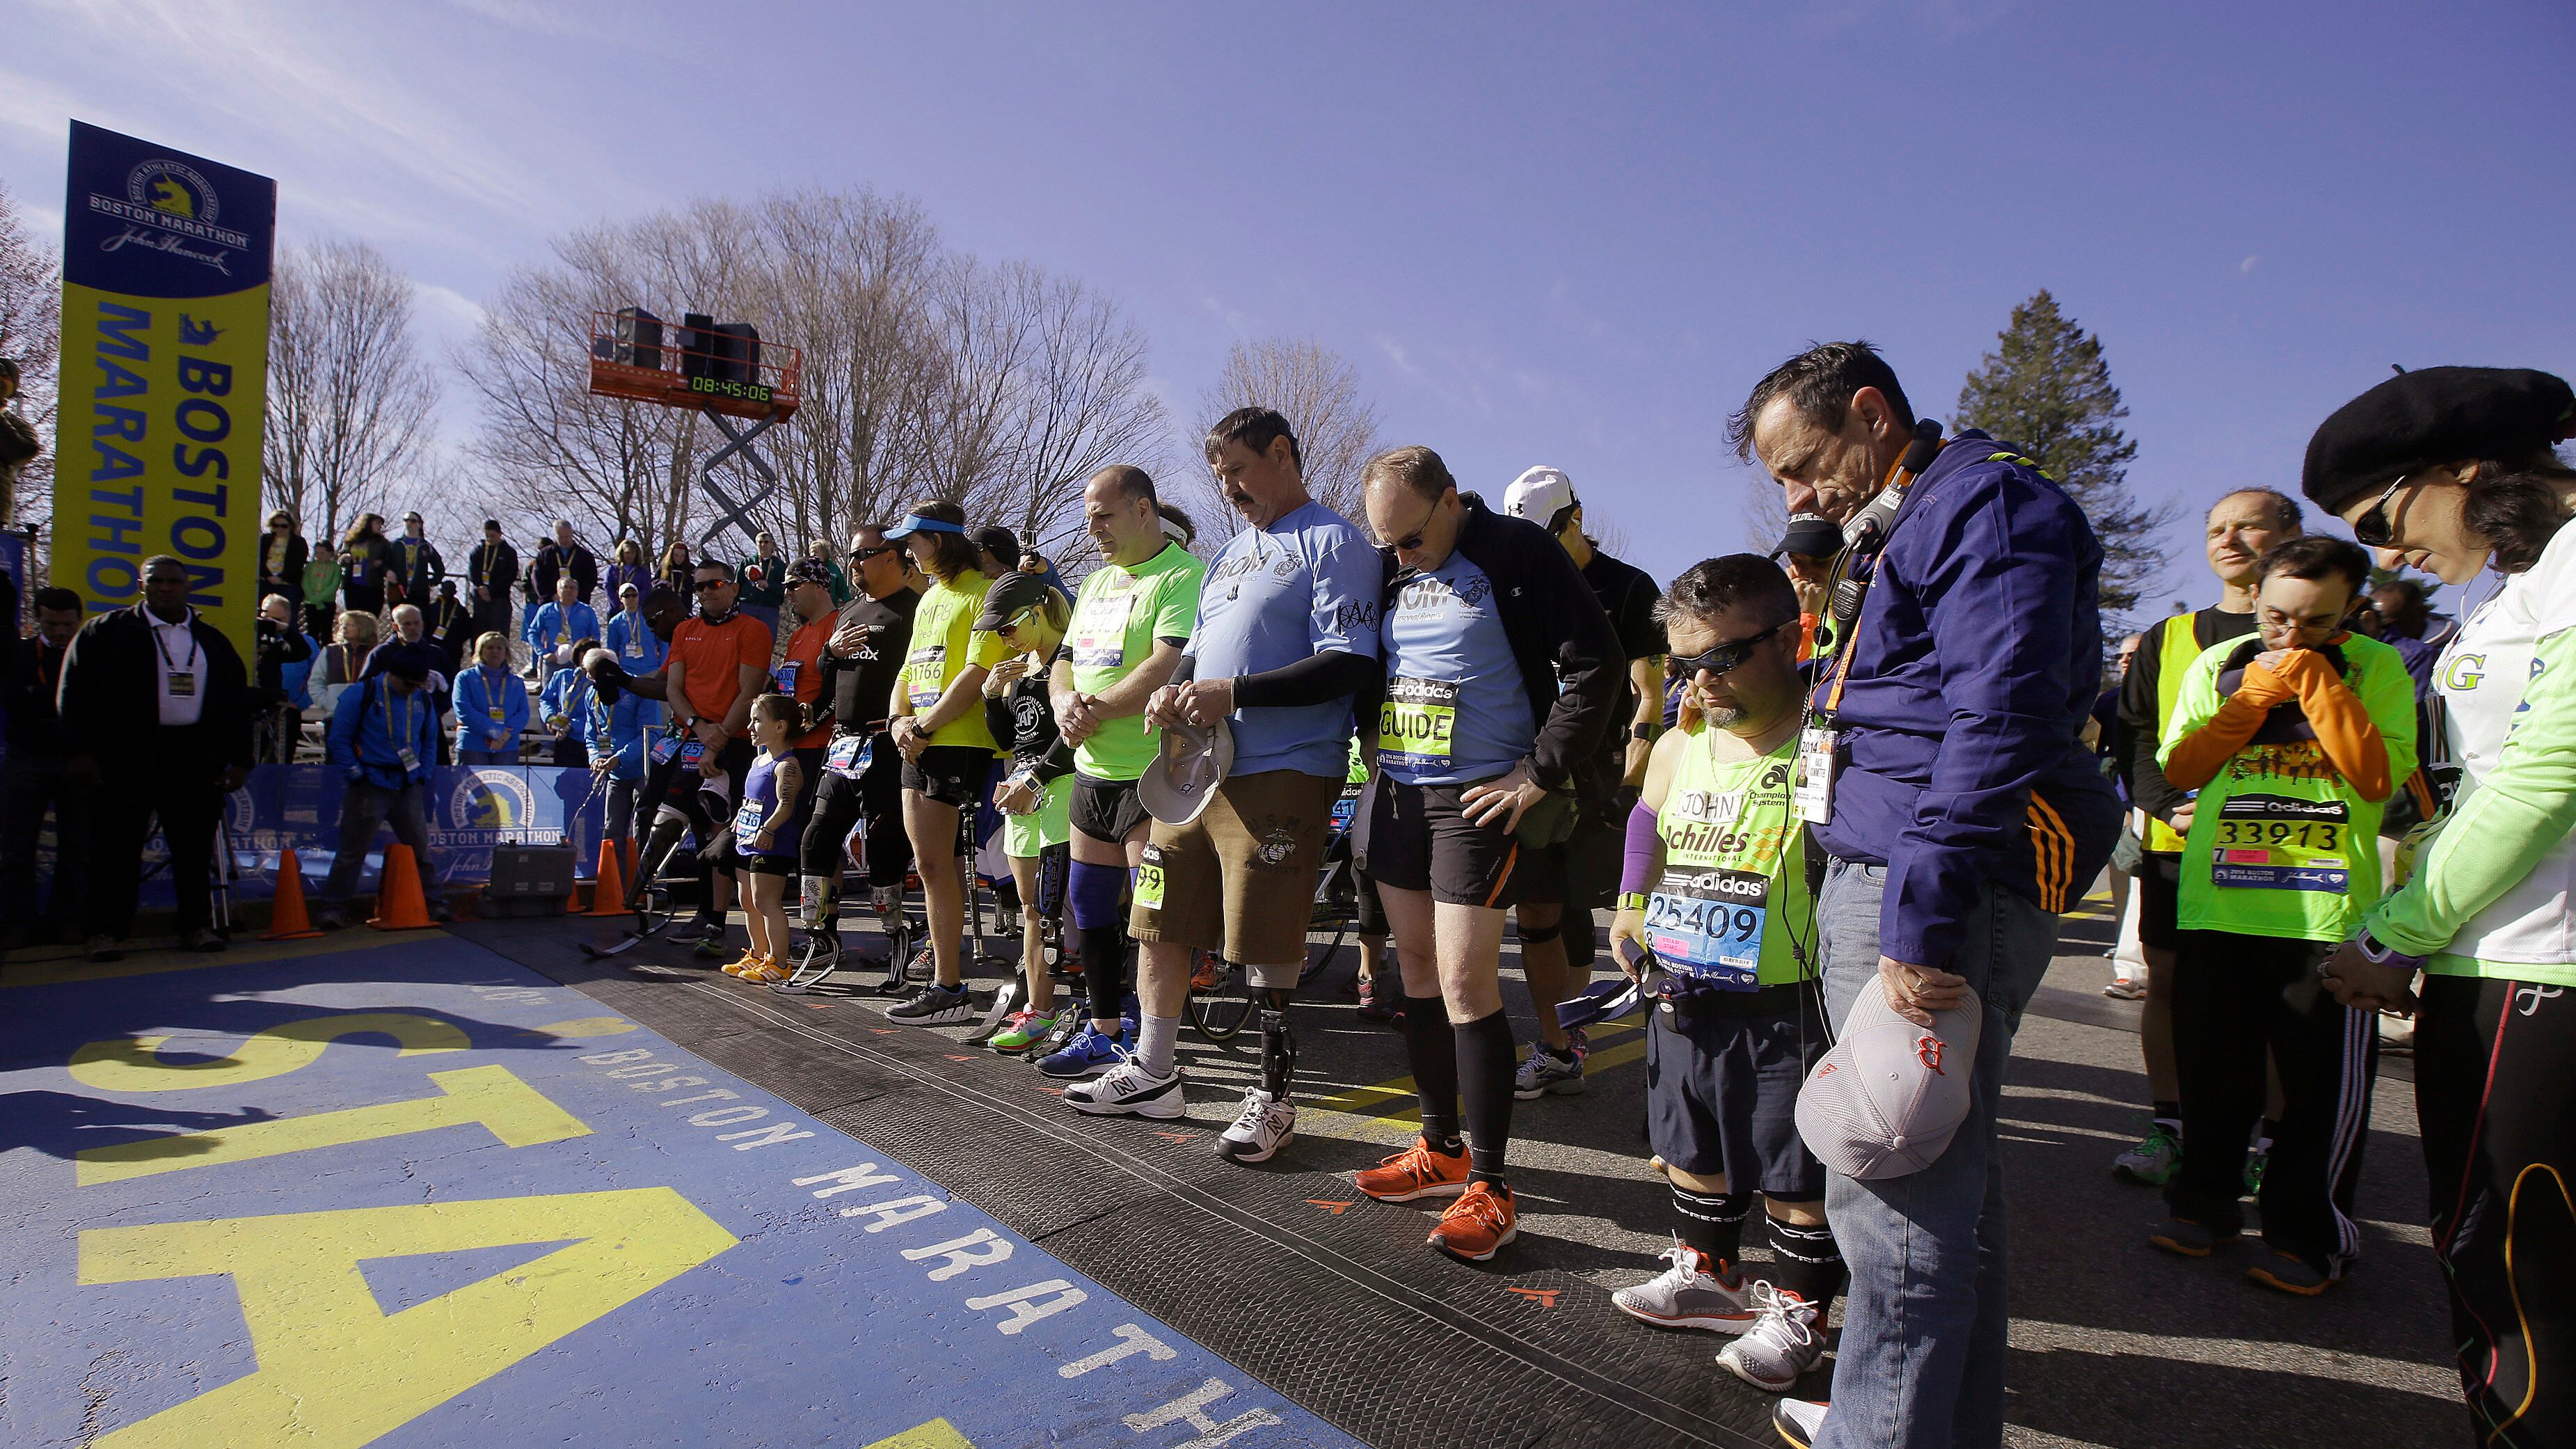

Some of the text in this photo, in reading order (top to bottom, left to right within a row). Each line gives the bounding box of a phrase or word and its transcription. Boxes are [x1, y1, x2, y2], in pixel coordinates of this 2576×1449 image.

[89, 196, 248, 249] BOSTON MARATHON
[692, 376, 769, 402] 08:45:06
[85, 301, 152, 612] MARATHO
[169, 355, 232, 607] BOSTON
[1405, 681, 1454, 699] adidas
[1380, 709, 1452, 741] GUIDE
[1801, 741, 1818, 754] 2014
[1682, 793, 1734, 819] JOHN
[1749, 791, 1792, 800] Champion
[2267, 802, 2343, 815] adidas
[427, 830, 561, 845] OSTON MARATHON
[2218, 821, 2337, 851] 33913
[1683, 853, 1742, 862] INTERNATIONAL
[2213, 847, 2225, 862] 7
[1050, 867, 1059, 892] STEP
[1689, 871, 1763, 898] adidas
[1646, 896, 1757, 943] 25409
[1671, 960, 1694, 972] BOSTON
[577, 1047, 817, 1153] BOSTON
